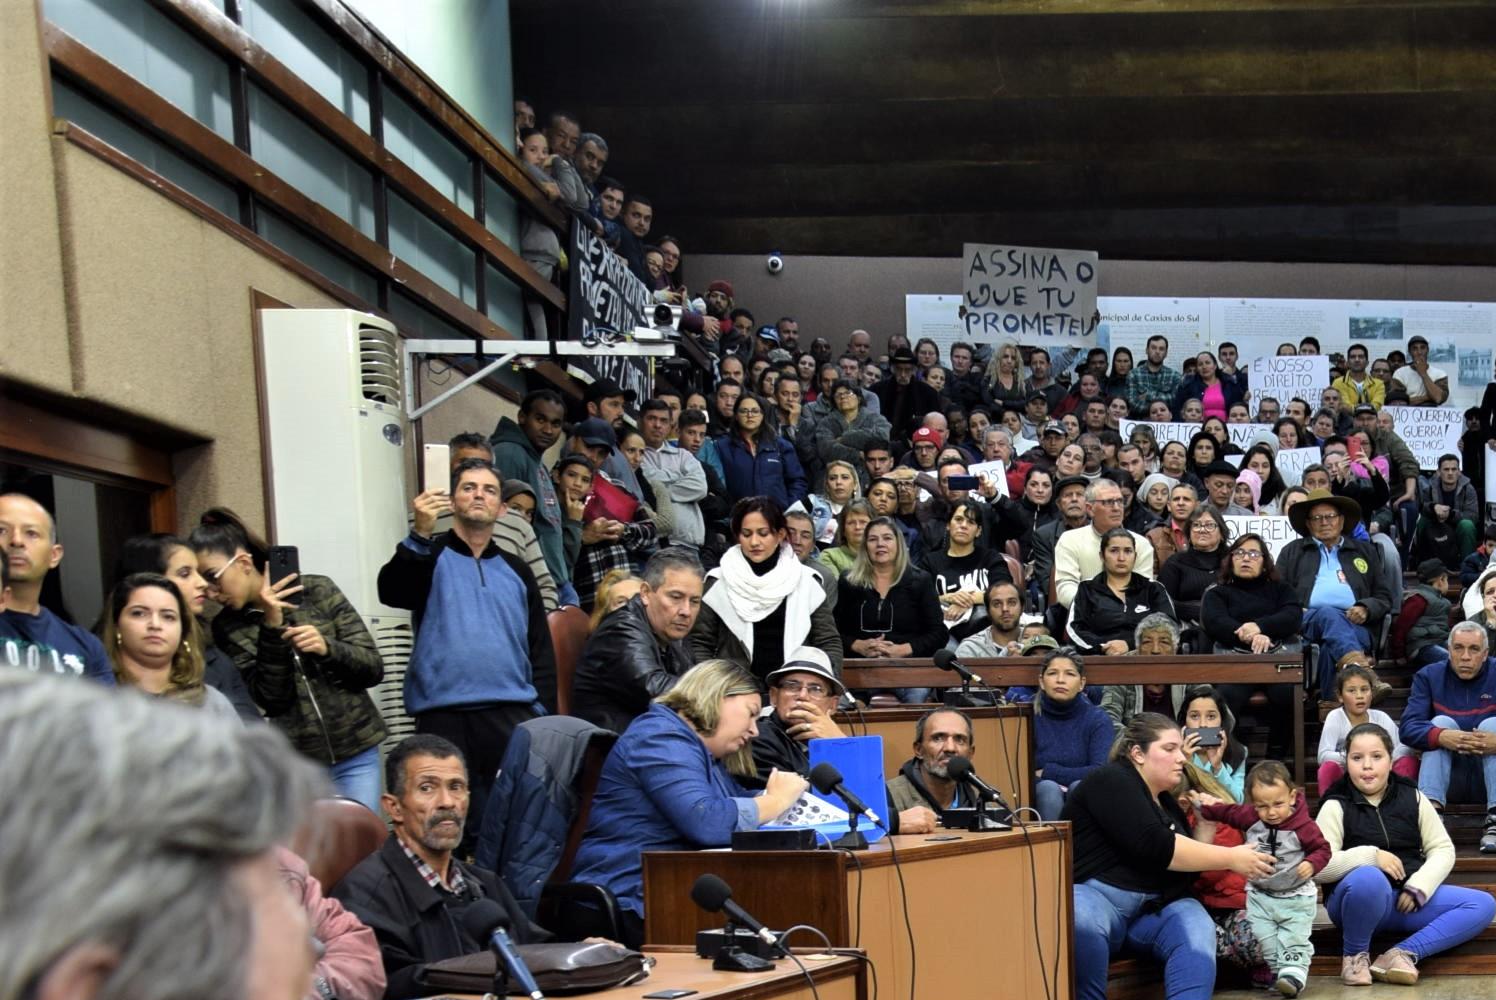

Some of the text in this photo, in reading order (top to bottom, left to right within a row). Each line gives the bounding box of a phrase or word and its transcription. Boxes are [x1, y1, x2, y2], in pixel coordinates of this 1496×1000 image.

[969, 250, 1094, 283] ASSINA O
[966, 283, 1075, 310] QUE TU
[965, 311, 1097, 336] PROMETEU
[1098, 313, 1130, 322] unicipal
[1131, 313, 1141, 321] de
[1186, 314, 1200, 322] Sul
[1268, 359, 1313, 372] NOSSO
[1263, 373, 1312, 388] DIREITO
[1412, 409, 1462, 424] QUEREMOS
[1403, 424, 1449, 439] GUERRA!
